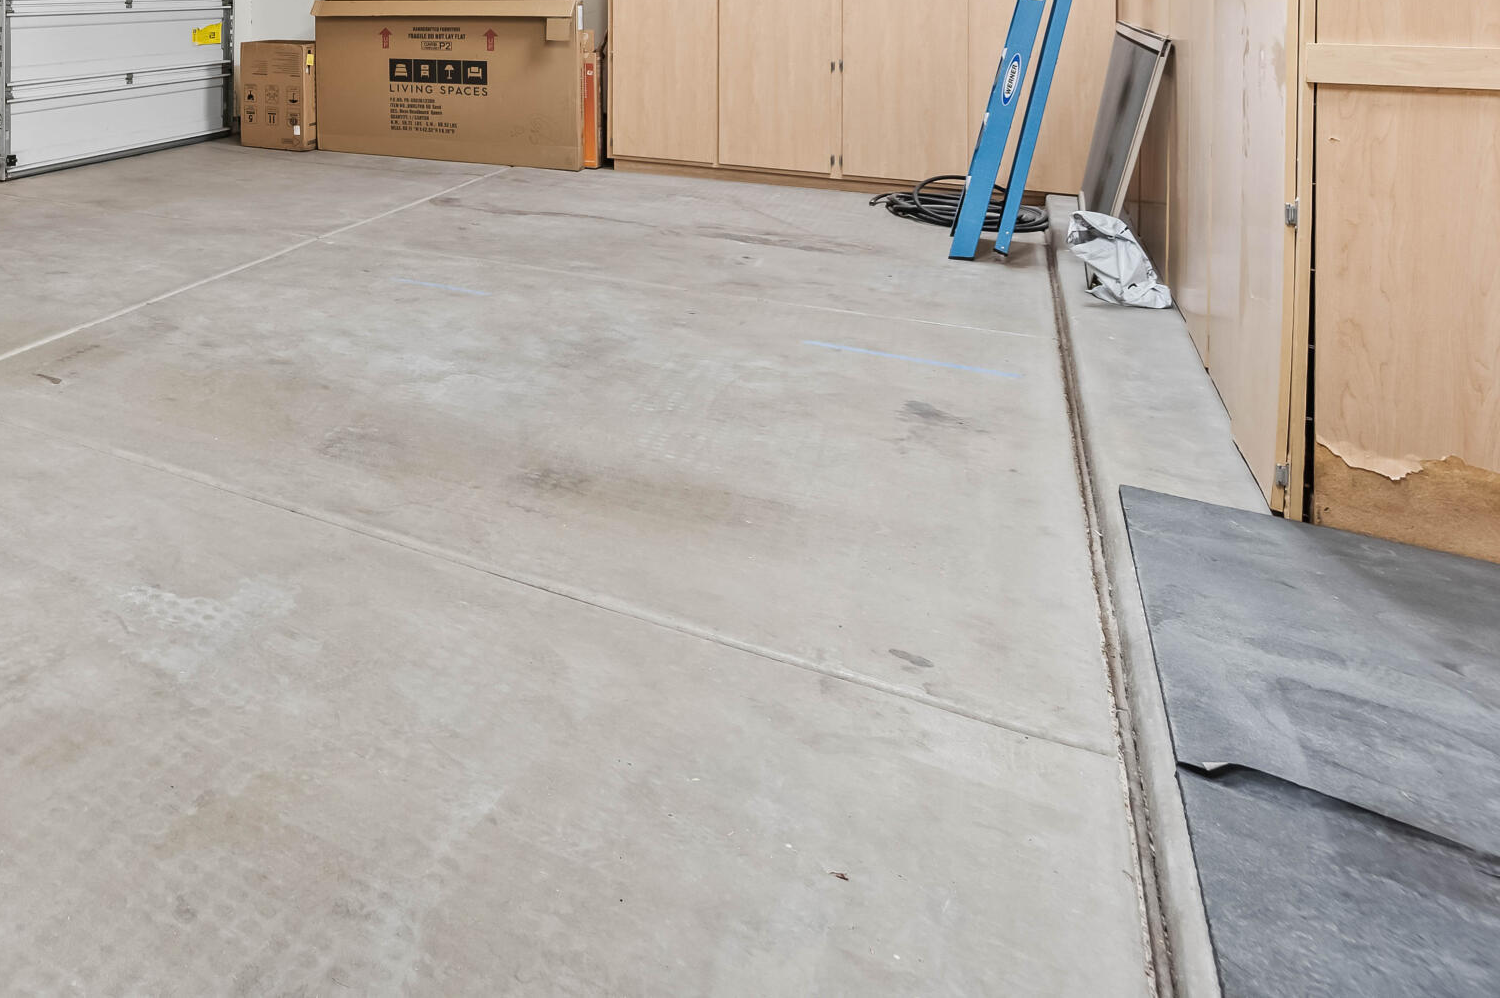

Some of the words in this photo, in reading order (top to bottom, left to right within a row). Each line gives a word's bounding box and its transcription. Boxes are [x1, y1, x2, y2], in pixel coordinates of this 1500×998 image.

[439, 41, 451, 50] P2
[1005, 64, 1018, 95] WERNER
[389, 83, 433, 94] LIVING
[439, 86, 488, 97] SPACES
